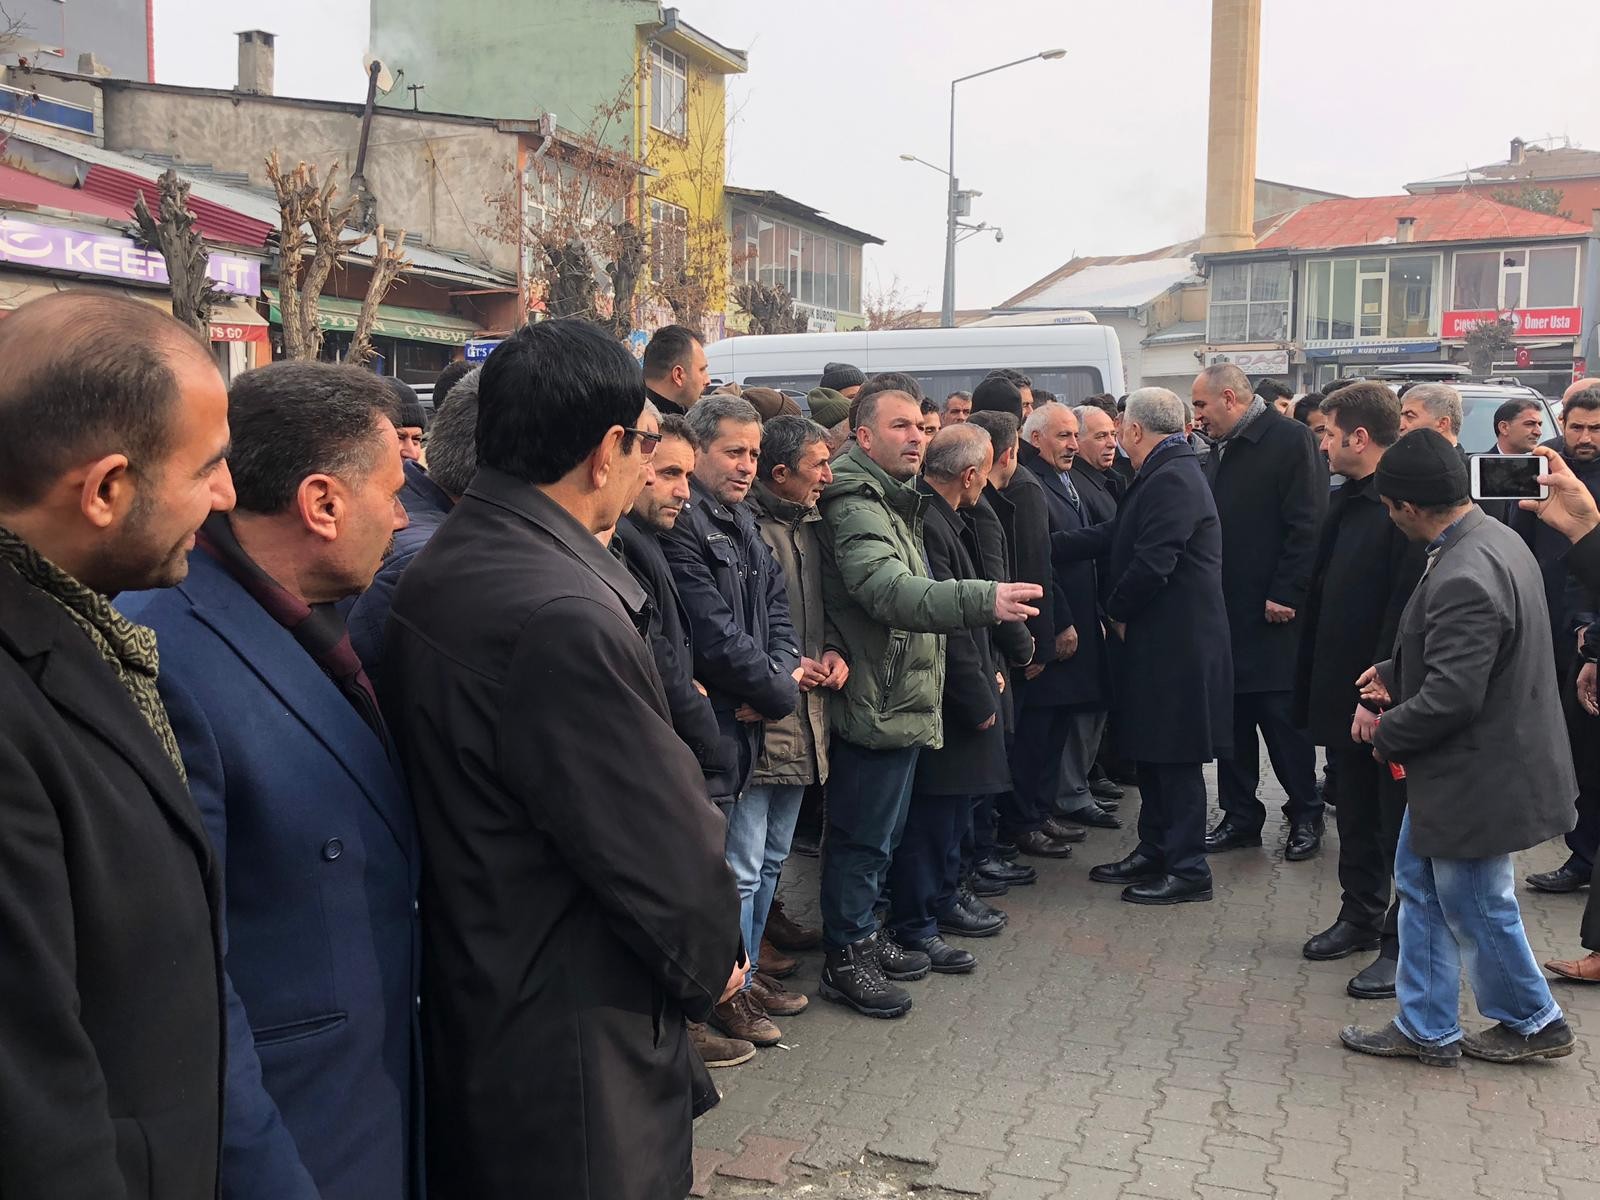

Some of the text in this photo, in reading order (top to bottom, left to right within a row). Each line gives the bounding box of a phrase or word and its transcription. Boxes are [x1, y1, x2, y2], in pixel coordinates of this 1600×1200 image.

[1524, 312, 1549, 329] Ömer
[1550, 315, 1571, 329] Usta
[227, 327, 242, 339] GO
